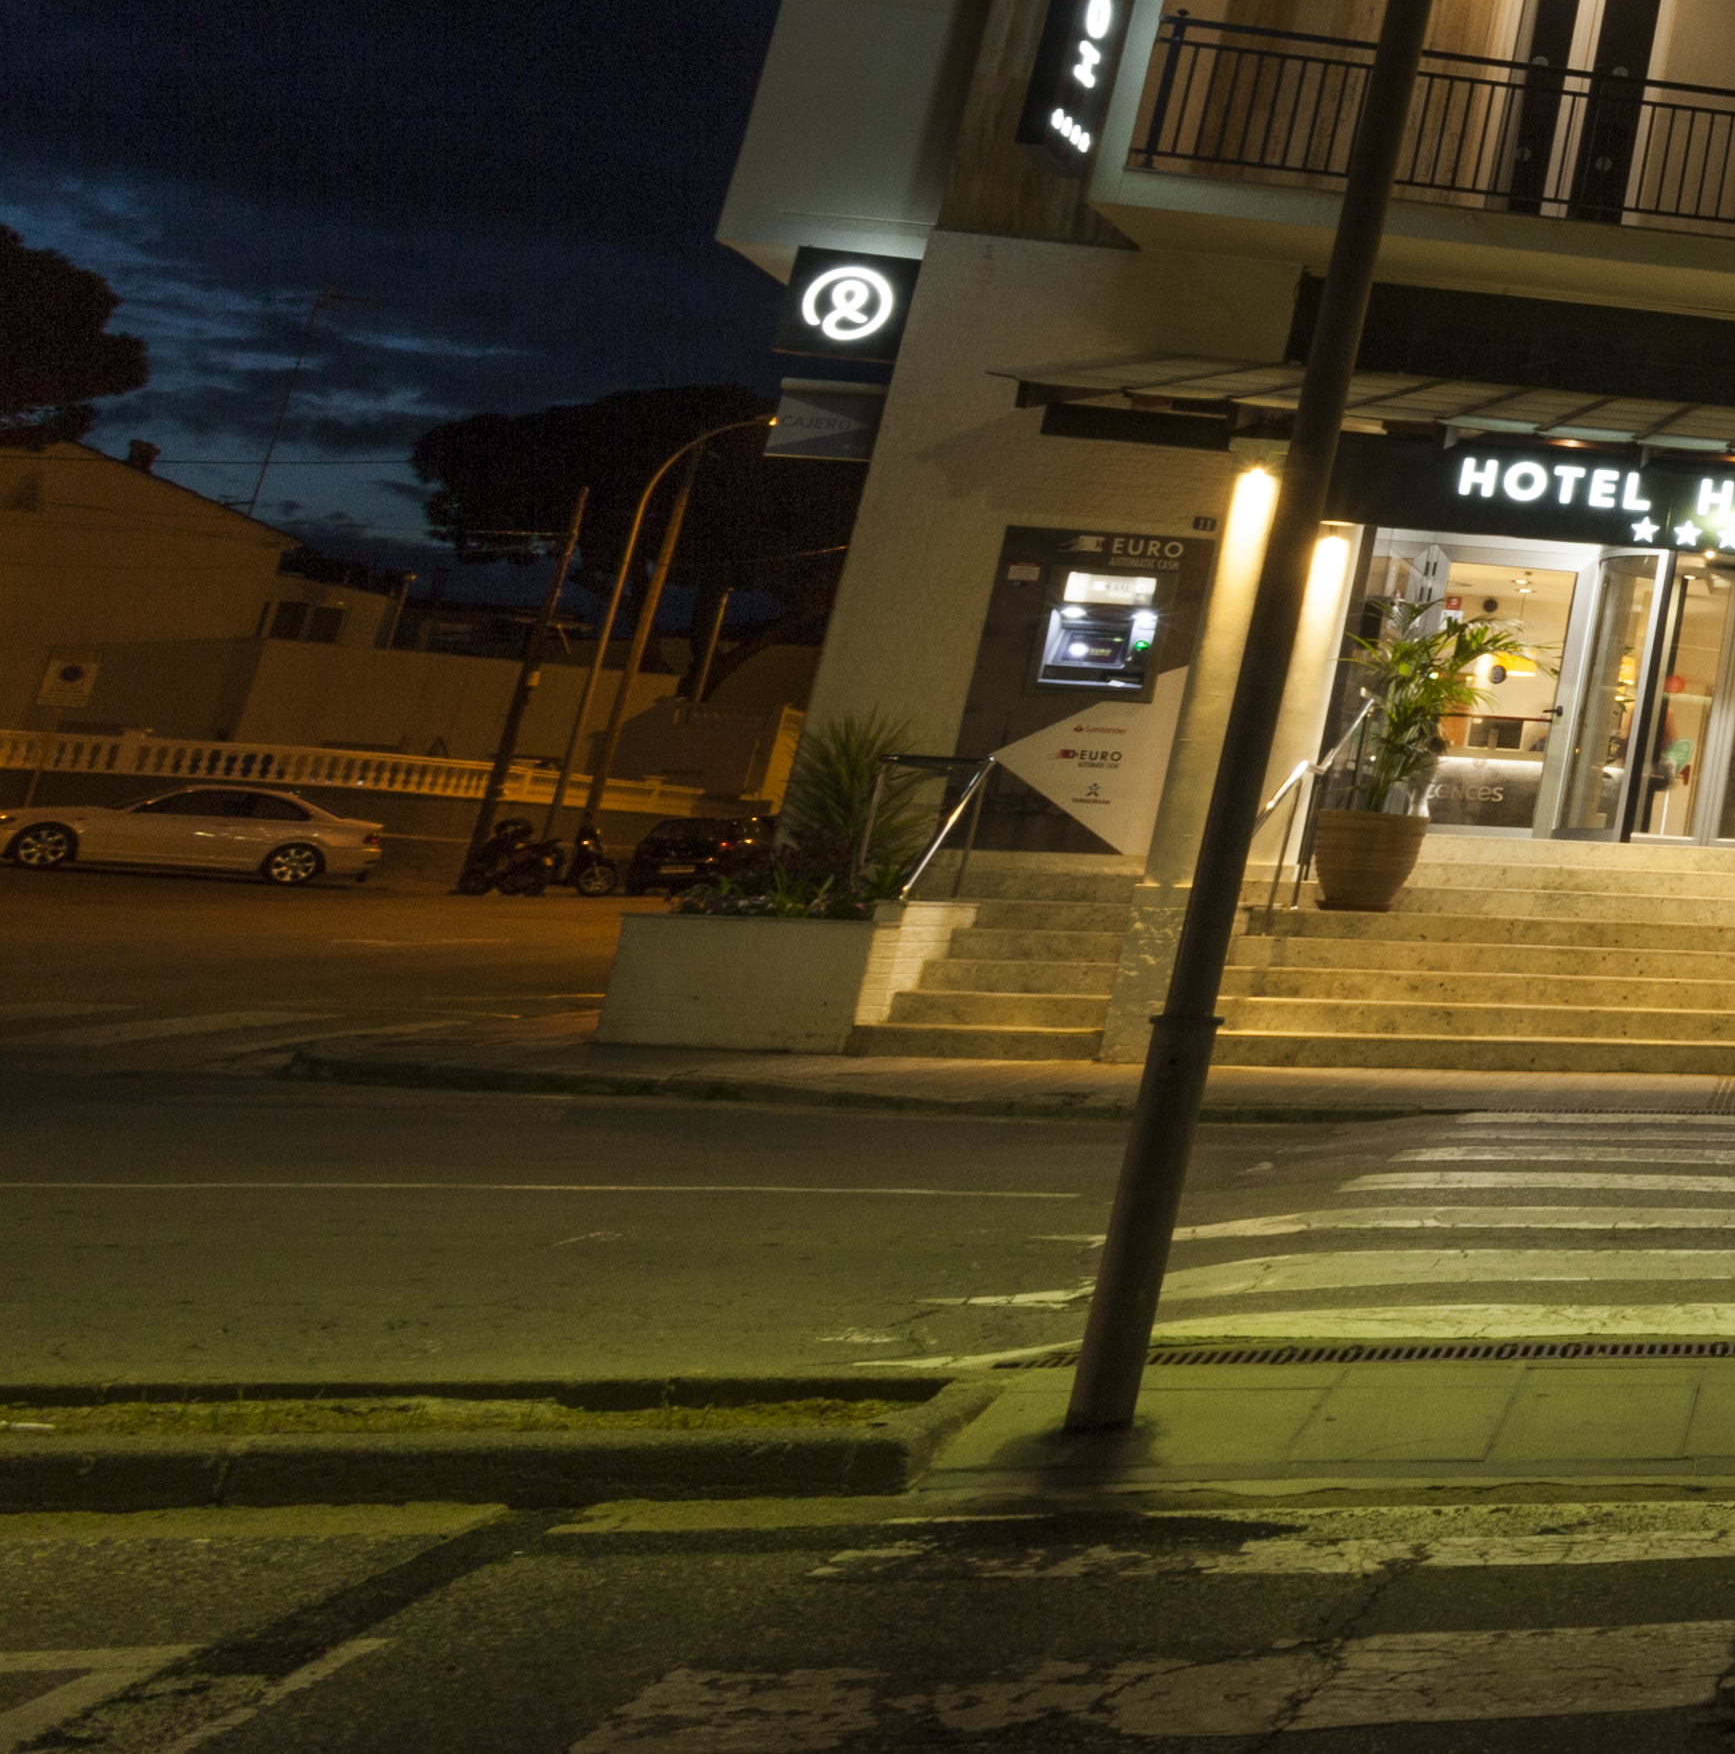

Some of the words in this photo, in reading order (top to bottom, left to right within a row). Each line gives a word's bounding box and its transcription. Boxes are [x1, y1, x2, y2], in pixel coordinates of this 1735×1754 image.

[782, 415, 851, 430] CAJERO
[1458, 457, 1651, 512] HOTEL
[1111, 538, 1184, 558] EURO
[1157, 560, 1180, 571] CASH
[1084, 725, 1128, 735] Santander
[1079, 750, 1122, 762] EURO
